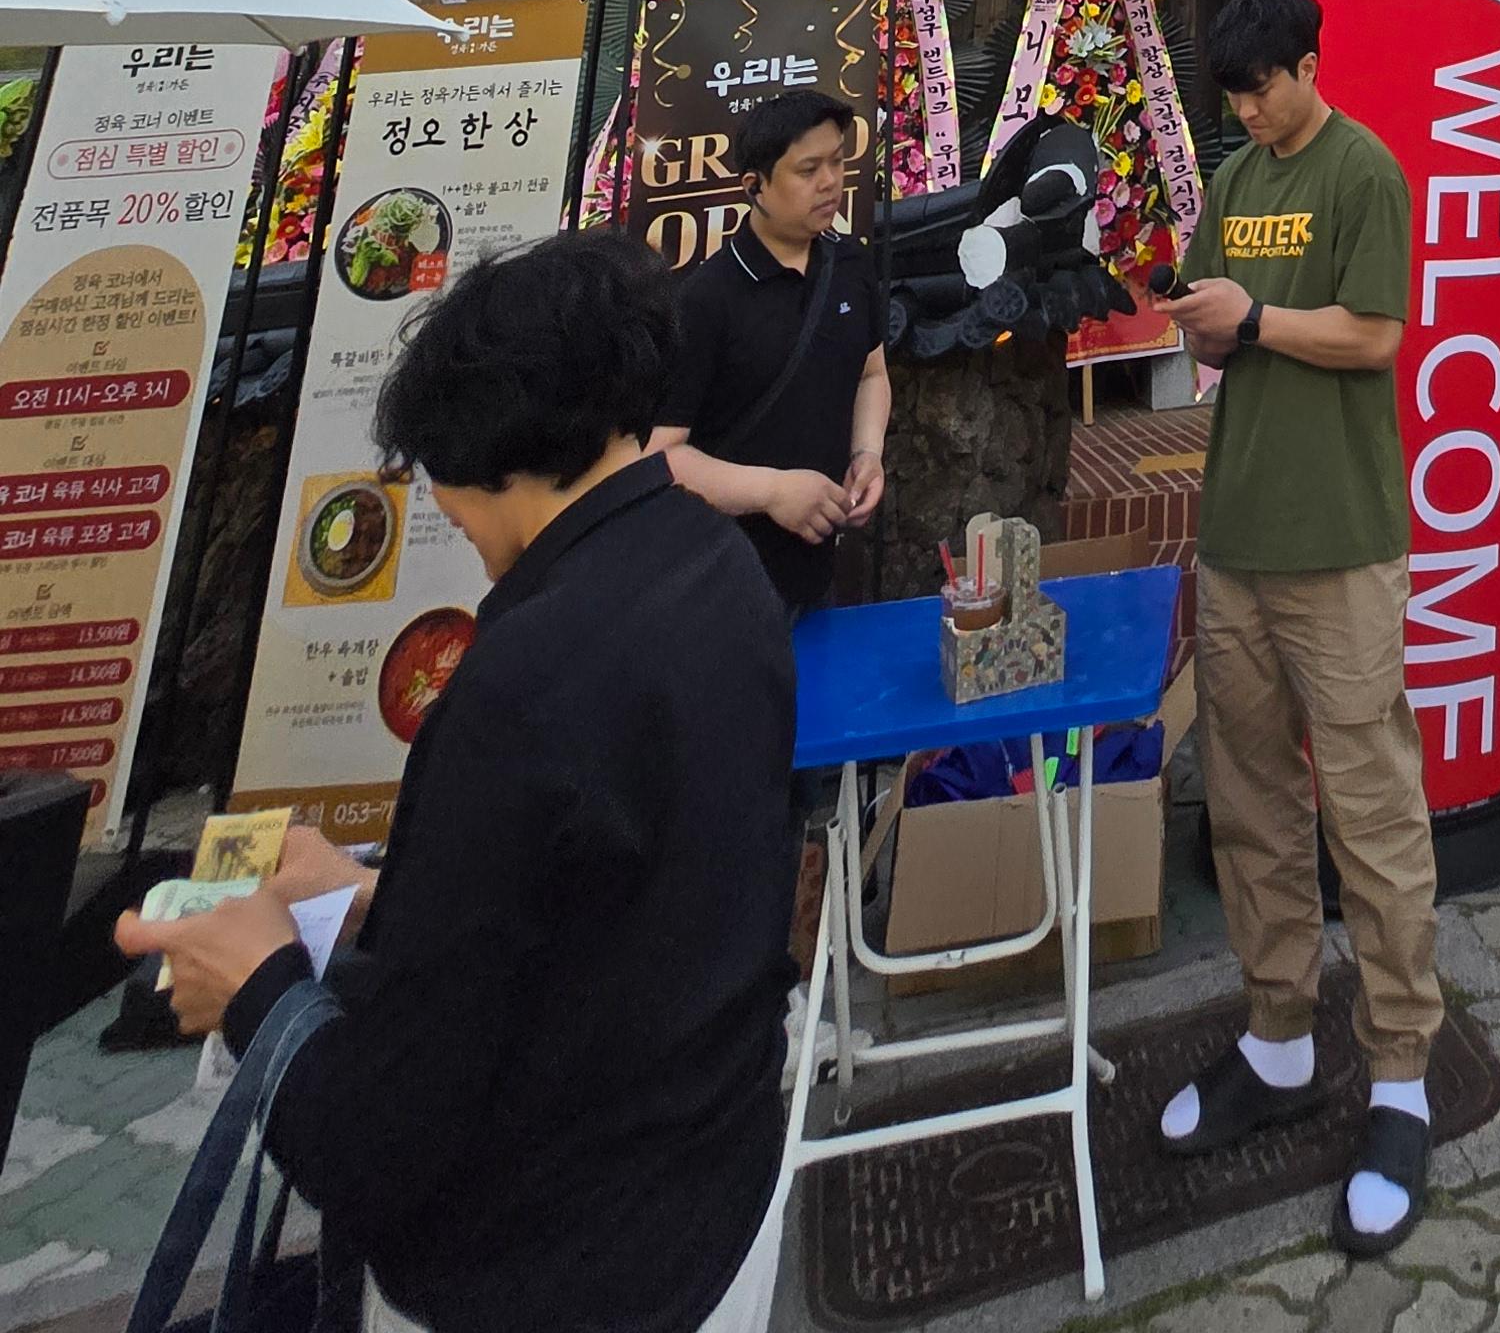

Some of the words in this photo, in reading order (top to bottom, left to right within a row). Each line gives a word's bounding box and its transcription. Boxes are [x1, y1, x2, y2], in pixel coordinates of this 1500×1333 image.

[123, 45, 214, 78] 우리는
[706, 55, 818, 97] 우리는
[1140, 46, 1166, 79] 항상
[368, 90, 414, 107] 우리는
[421, 84, 511, 105] 정육가든에서
[517, 79, 562, 97] 즐기는
[924, 48, 953, 115] 랜드마크
[94, 115, 126, 132] 정육
[130, 112, 161, 129] 코너
[167, 109, 214, 127] 이벤트
[382, 116, 446, 156] 정오
[460, 111, 493, 151] 한
[504, 107, 538, 147] 상
[75, 144, 118, 171] 점심
[126, 141, 168, 167] 특별
[177, 137, 219, 164] 할인
[640, 116, 869, 189] GRD
[31, 199, 111, 231] 전품목
[118, 191, 180, 225] 20%
[185, 190, 234, 221] 할인
[11, 387, 49, 410] 오전
[142, 378, 170, 401] 3시
[13, 483, 47, 504] 코너
[90, 477, 122, 497] 식사
[2, 528, 37, 550] 코너
